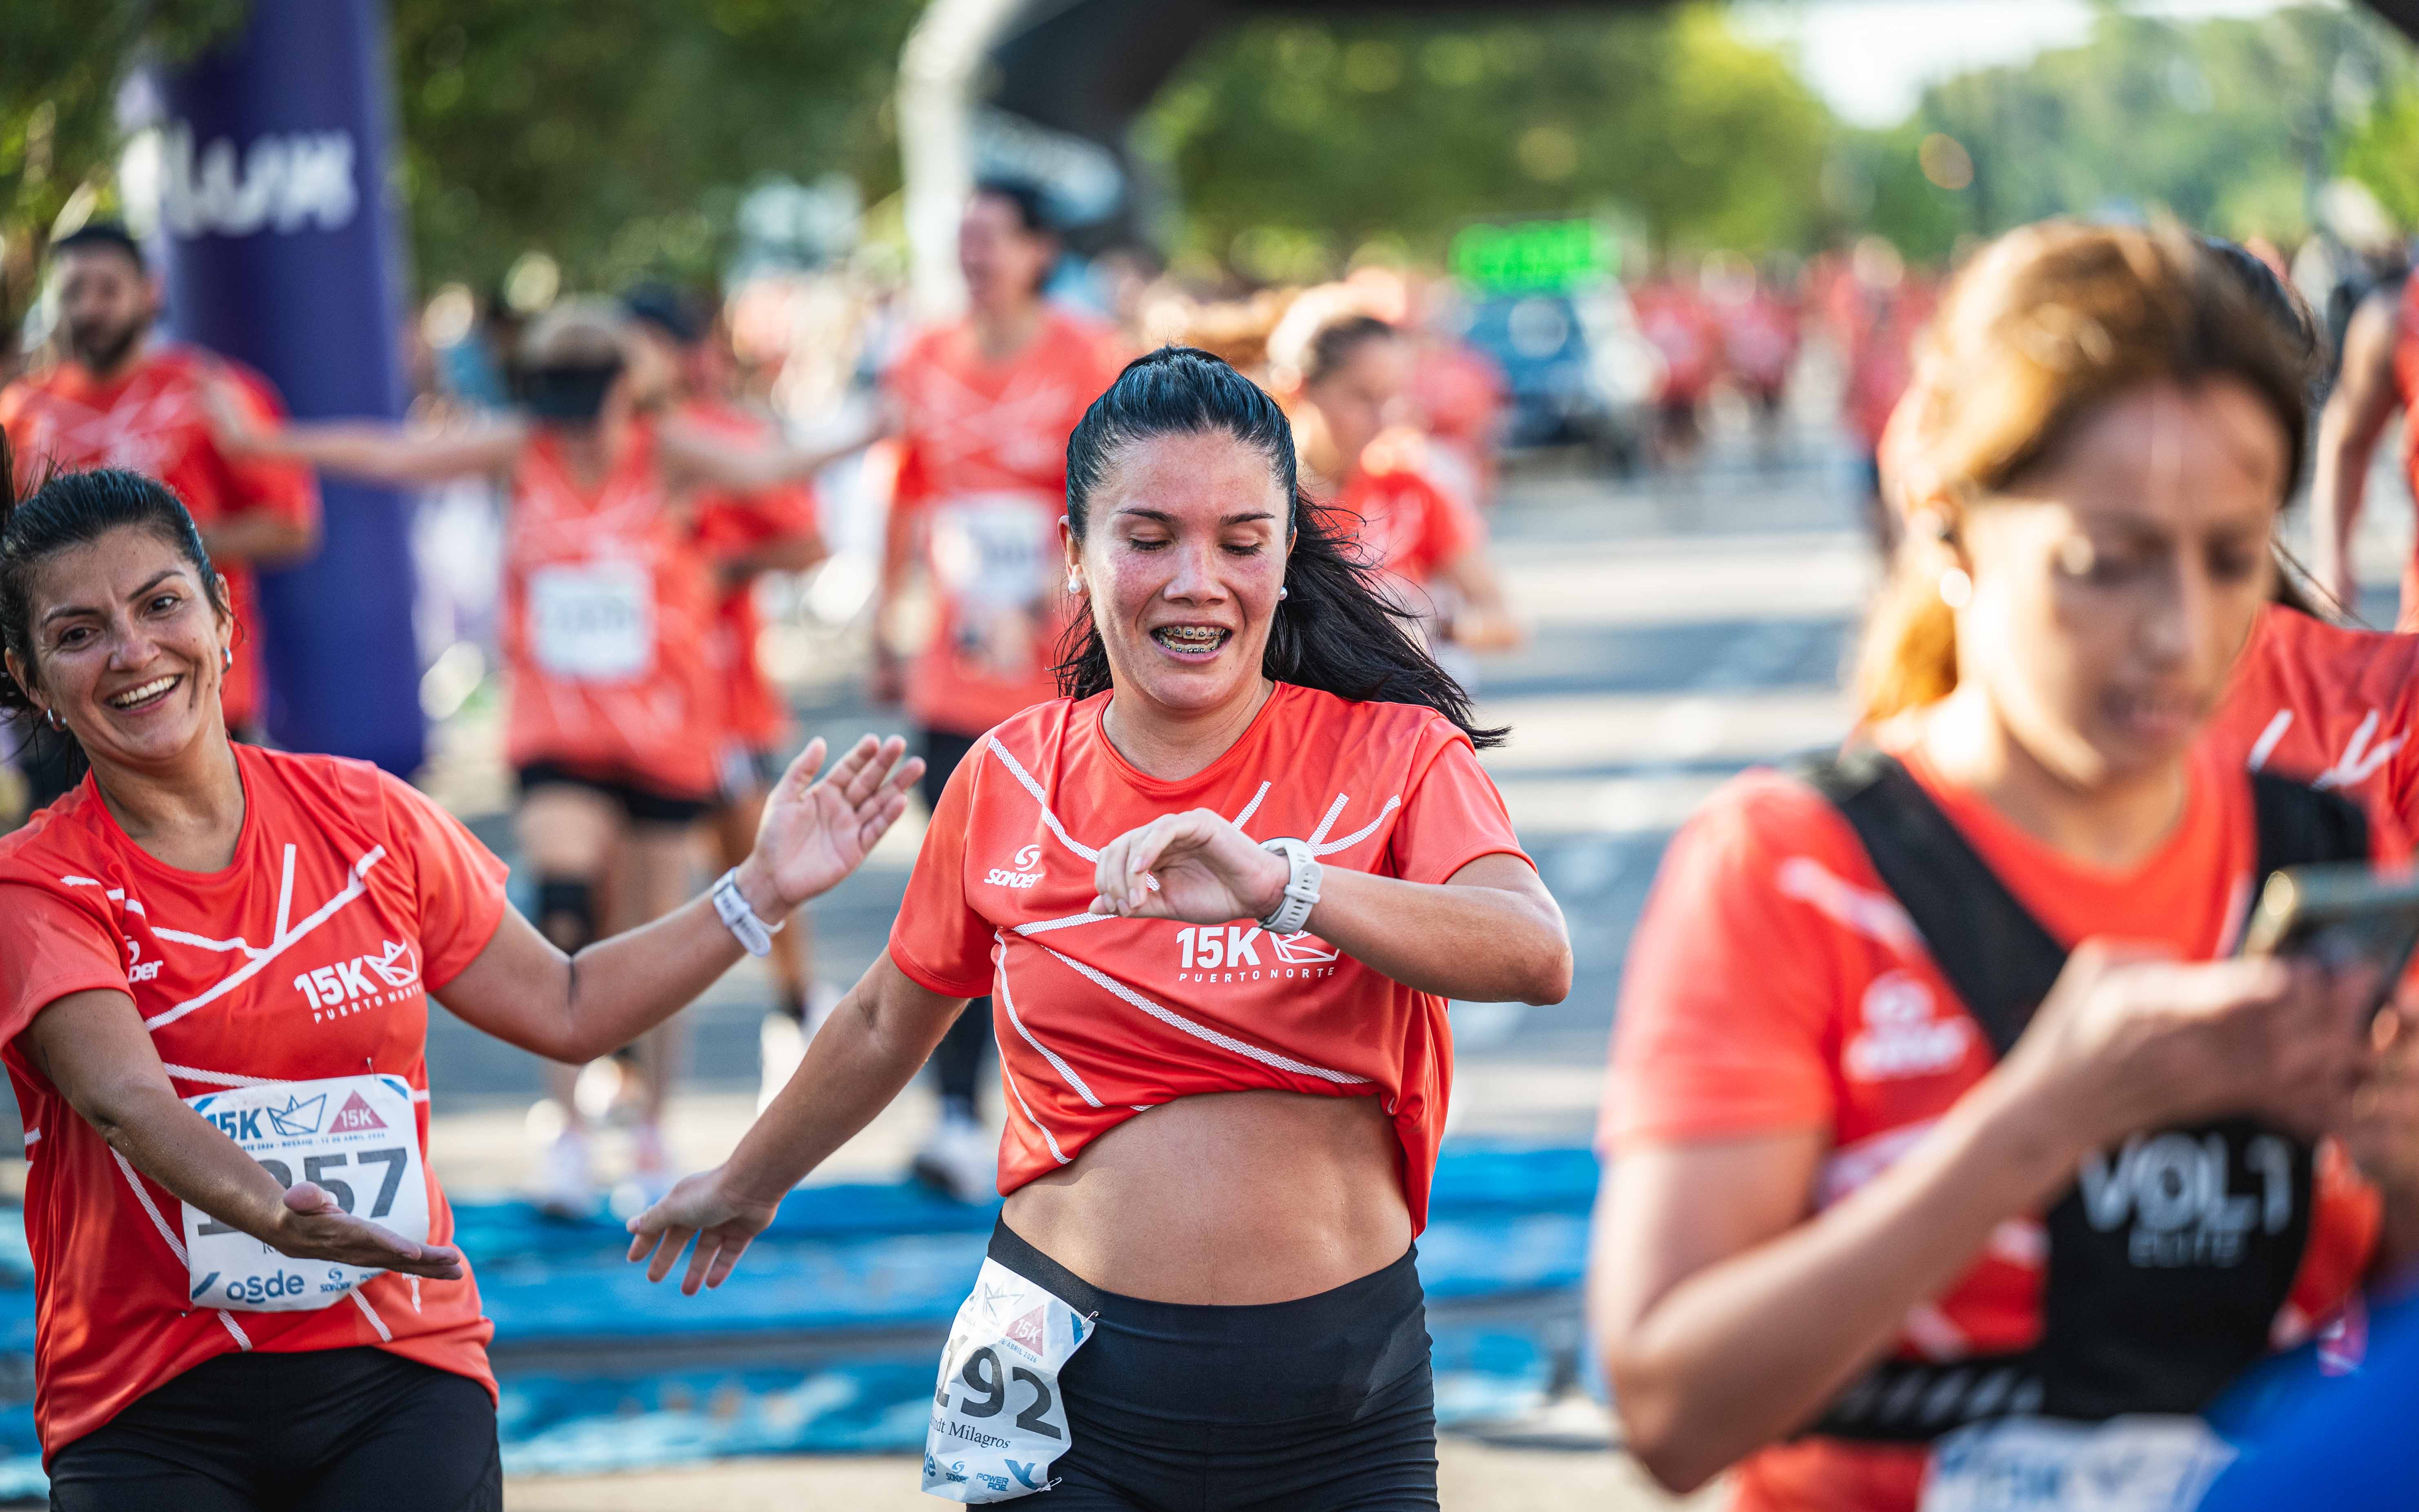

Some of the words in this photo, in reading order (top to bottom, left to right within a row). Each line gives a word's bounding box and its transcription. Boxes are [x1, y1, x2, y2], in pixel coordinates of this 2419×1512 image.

[1176, 926, 1263, 969] 15K
[293, 957, 378, 1010] 15K
[1179, 970, 1260, 984] PUERTO
[1270, 966, 1335, 979] NORTE
[313, 995, 383, 1024] PUERTO
[341, 1108, 373, 1129] 15K
[197, 1147, 408, 1236] 57
[226, 1268, 304, 1303] osde
[1015, 1319, 1042, 1345] 15K
[1006, 1341, 1022, 1355] ABRIL
[1023, 1351, 1037, 1363] 2026
[934, 1334, 1062, 1440] 192
[948, 1421, 1011, 1449] Milagros
[976, 1473, 1009, 1485] POWER
